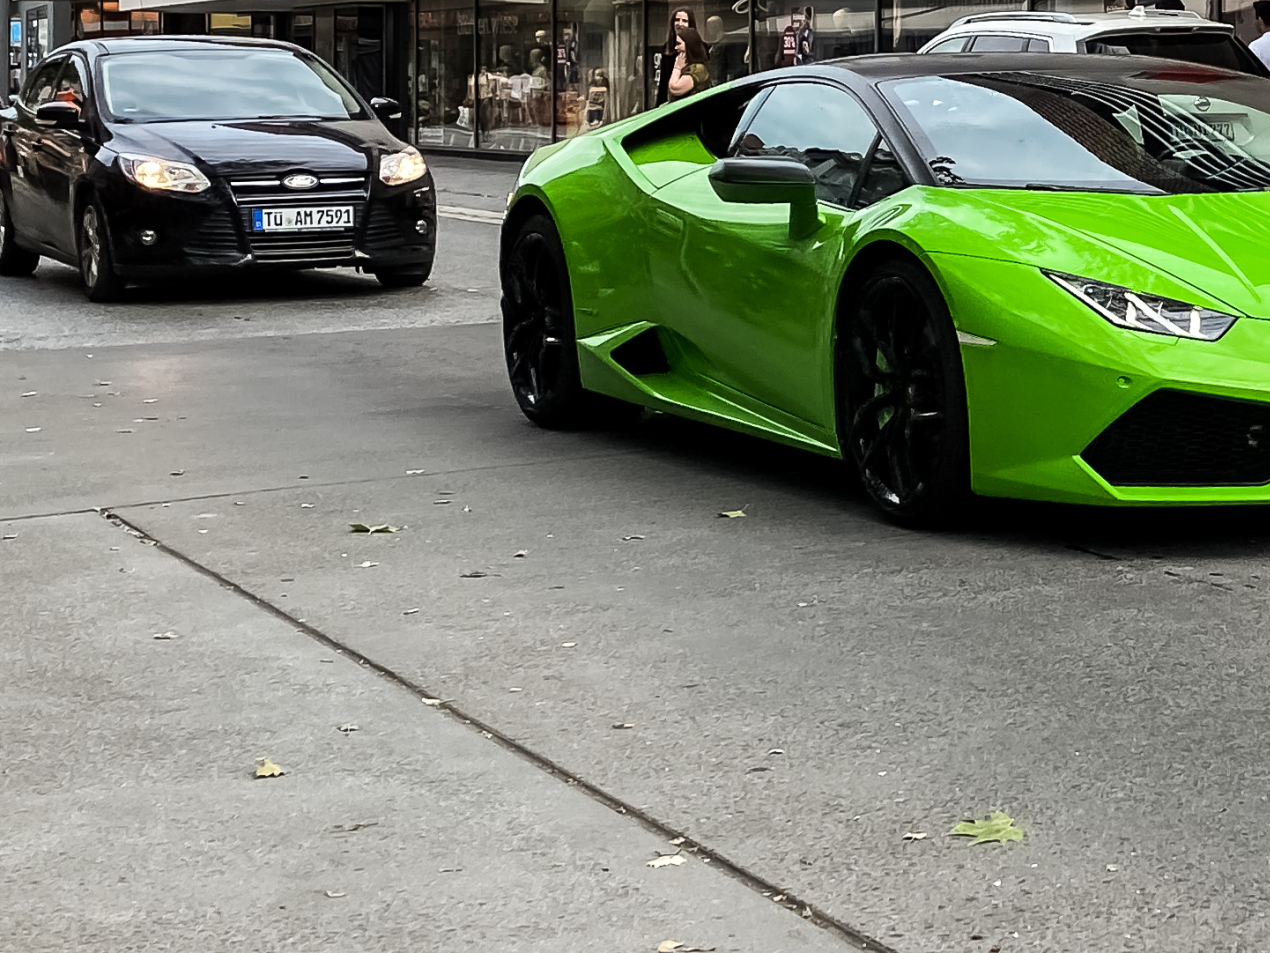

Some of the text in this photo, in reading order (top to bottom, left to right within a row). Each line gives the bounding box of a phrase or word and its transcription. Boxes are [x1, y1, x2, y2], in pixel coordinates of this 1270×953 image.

[263, 211, 283, 227] TÜ
[294, 210, 314, 226] AM
[316, 208, 352, 225] 7591
